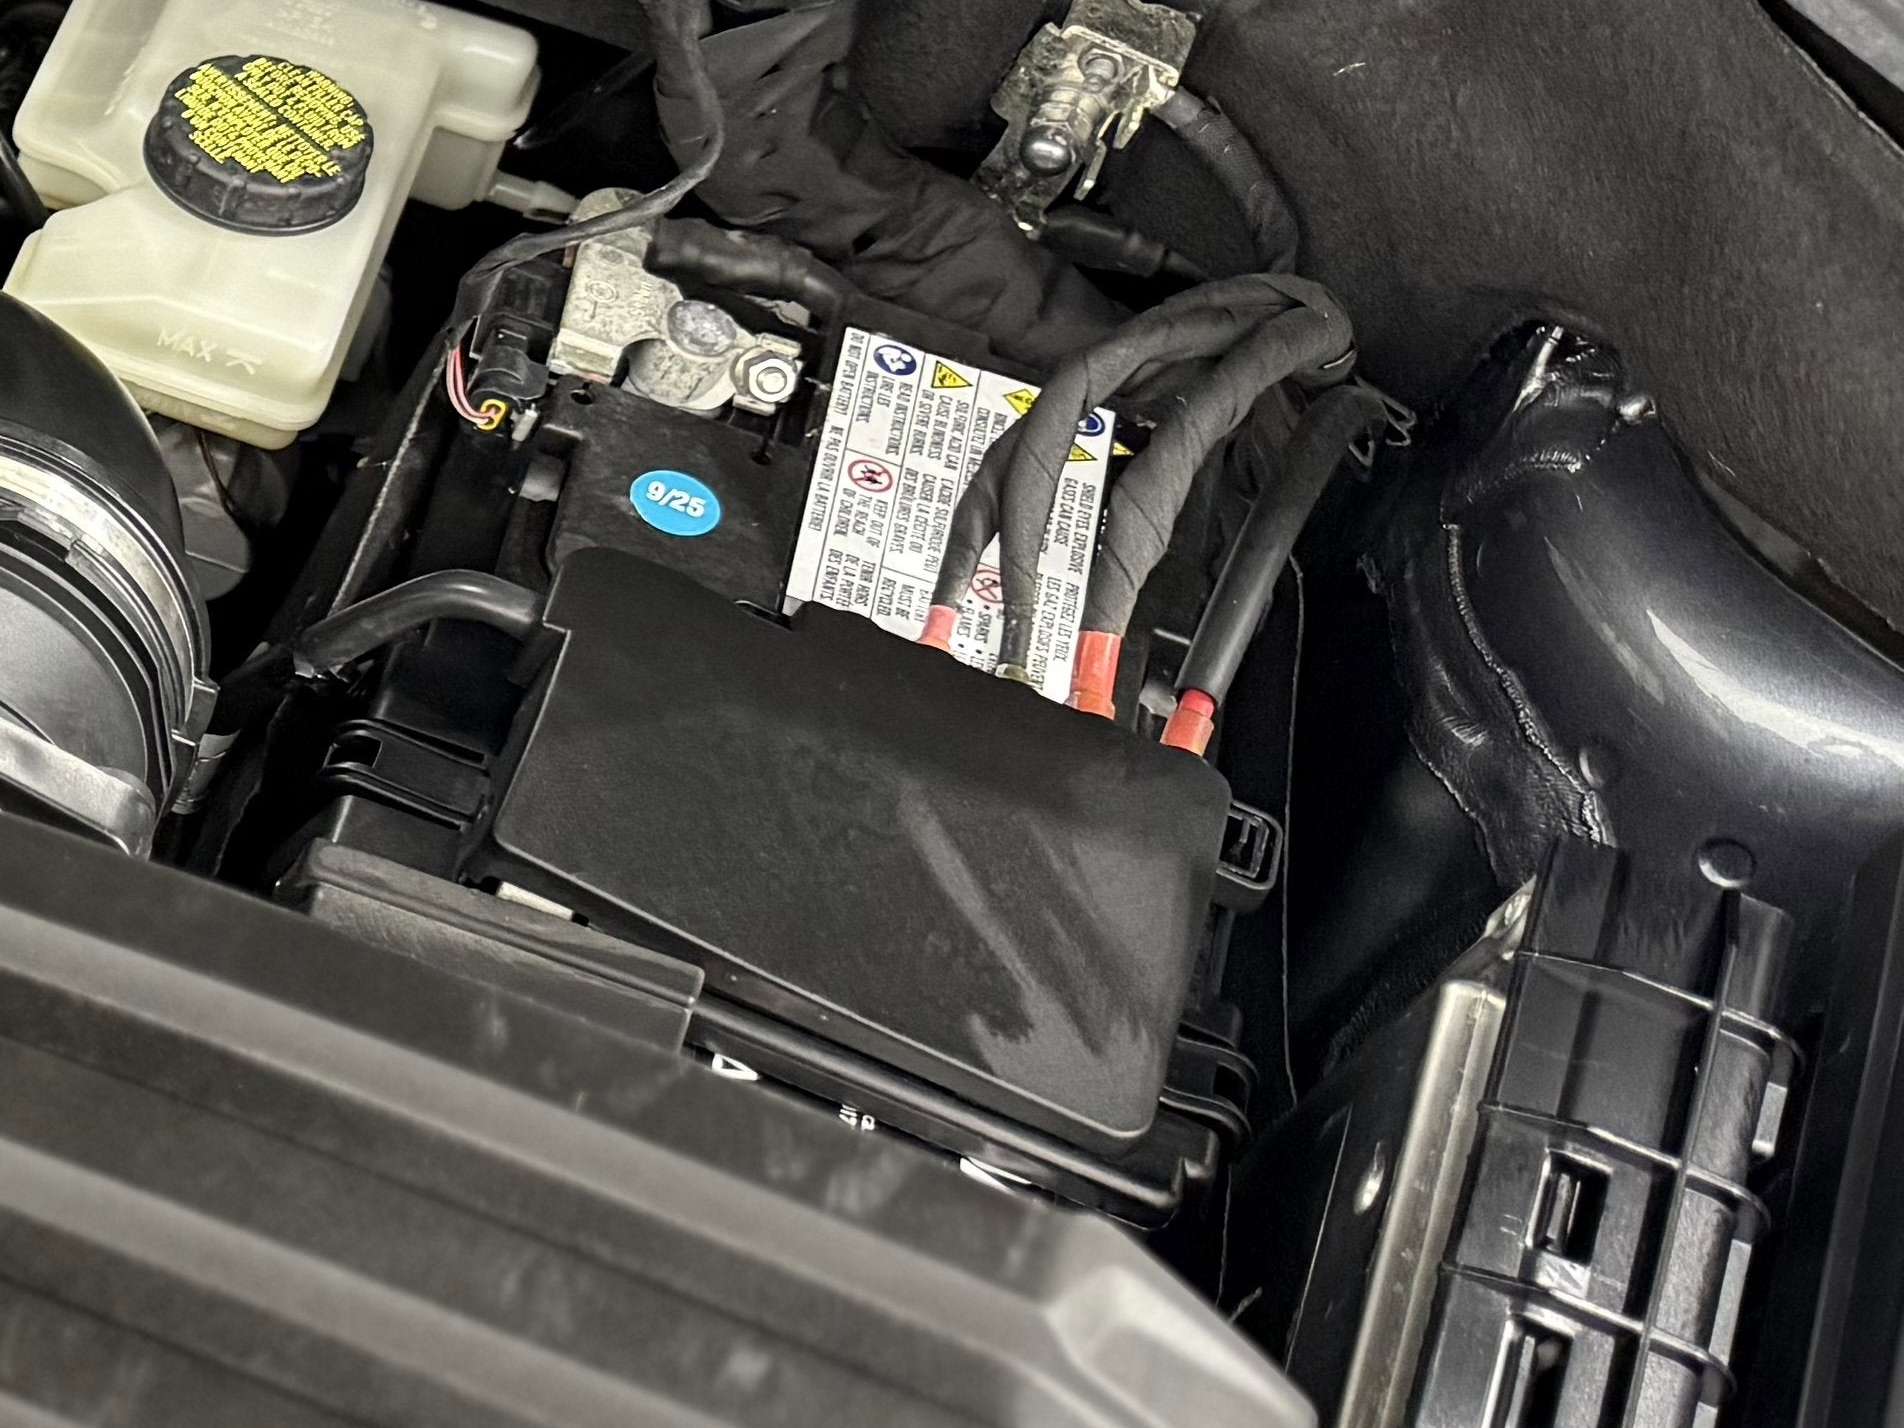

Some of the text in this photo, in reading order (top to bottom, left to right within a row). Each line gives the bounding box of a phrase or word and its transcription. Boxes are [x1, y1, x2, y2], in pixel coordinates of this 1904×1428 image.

[847, 344, 862, 359] NOT
[842, 360, 858, 380] OPEN
[876, 392, 891, 407] LES
[896, 381, 913, 402] READ
[828, 424, 844, 437] NE
[926, 394, 952, 460] CAUSE BLINDNESS
[825, 436, 841, 452] PAS
[943, 453, 959, 470] CAN
[903, 467, 919, 483] DES
[816, 481, 831, 492] LA
[841, 487, 856, 498] OF
[918, 472, 936, 502] CAUSER
[646, 481, 706, 518] 9/25
[916, 502, 931, 514] LA
[851, 493, 872, 536] THE REACH
[1057, 501, 1074, 521] CAN
[865, 498, 888, 548] KEEP OUT OF
[1053, 520, 1072, 546] CAUSE
[827, 547, 843, 565] DES
[908, 540, 924, 554] OU
[1065, 531, 1090, 574] EXPLOSIVE
[844, 553, 860, 566] DE
[842, 565, 856, 578] LA
[1045, 576, 1062, 592] LES
[895, 583, 914, 619] MUST BE
[1042, 591, 1059, 610] GAZ
[972, 611, 992, 643] SPARKS
[1033, 609, 1057, 653] EXPLOSIFS
[1057, 622, 1072, 638] LES
